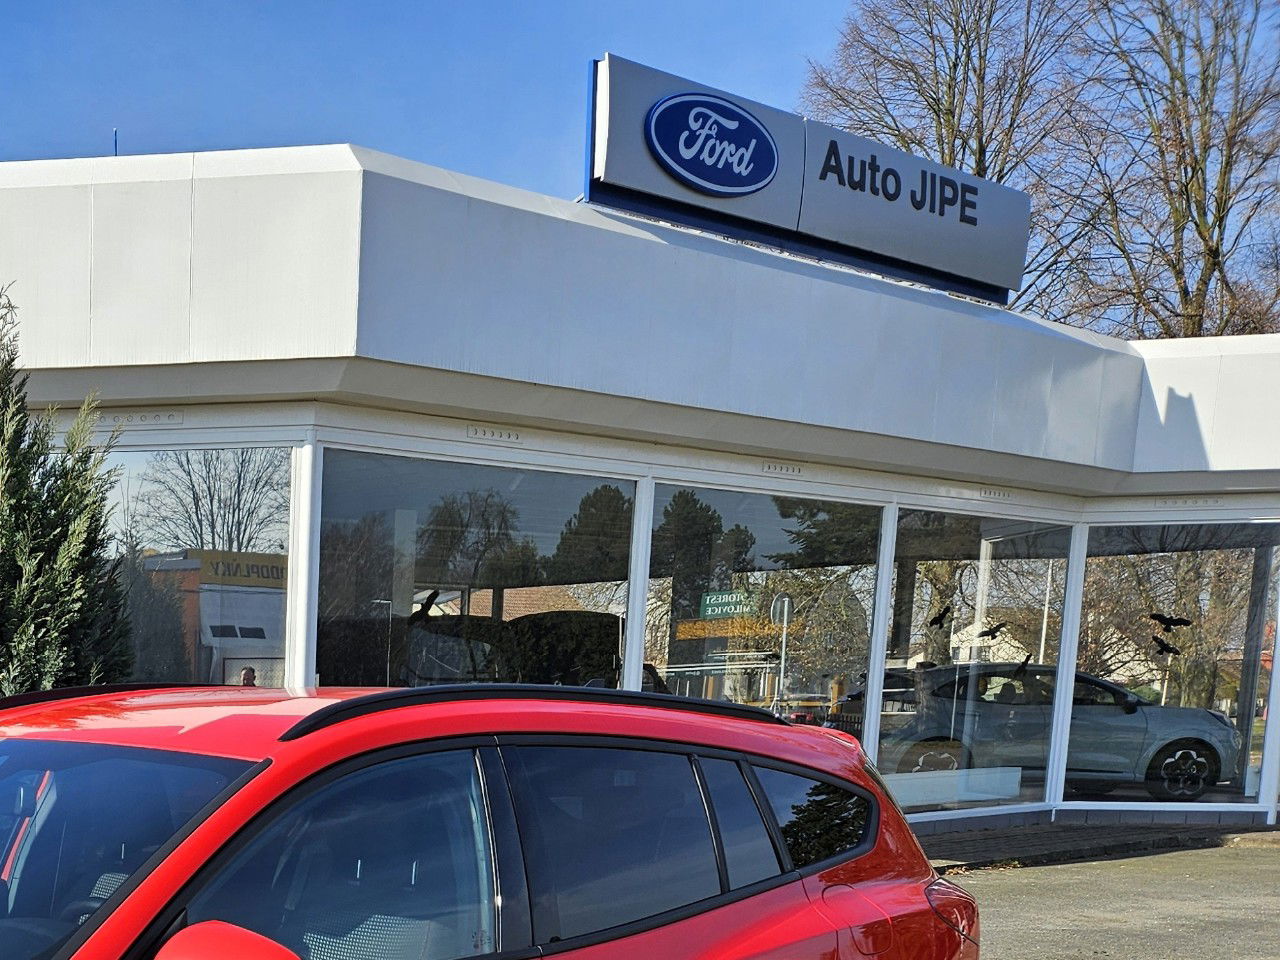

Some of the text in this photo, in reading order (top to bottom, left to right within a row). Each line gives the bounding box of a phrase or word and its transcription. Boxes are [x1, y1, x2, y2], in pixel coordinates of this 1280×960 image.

[678, 106, 757, 177] Ford
[819, 139, 978, 226] Auto JIPE
